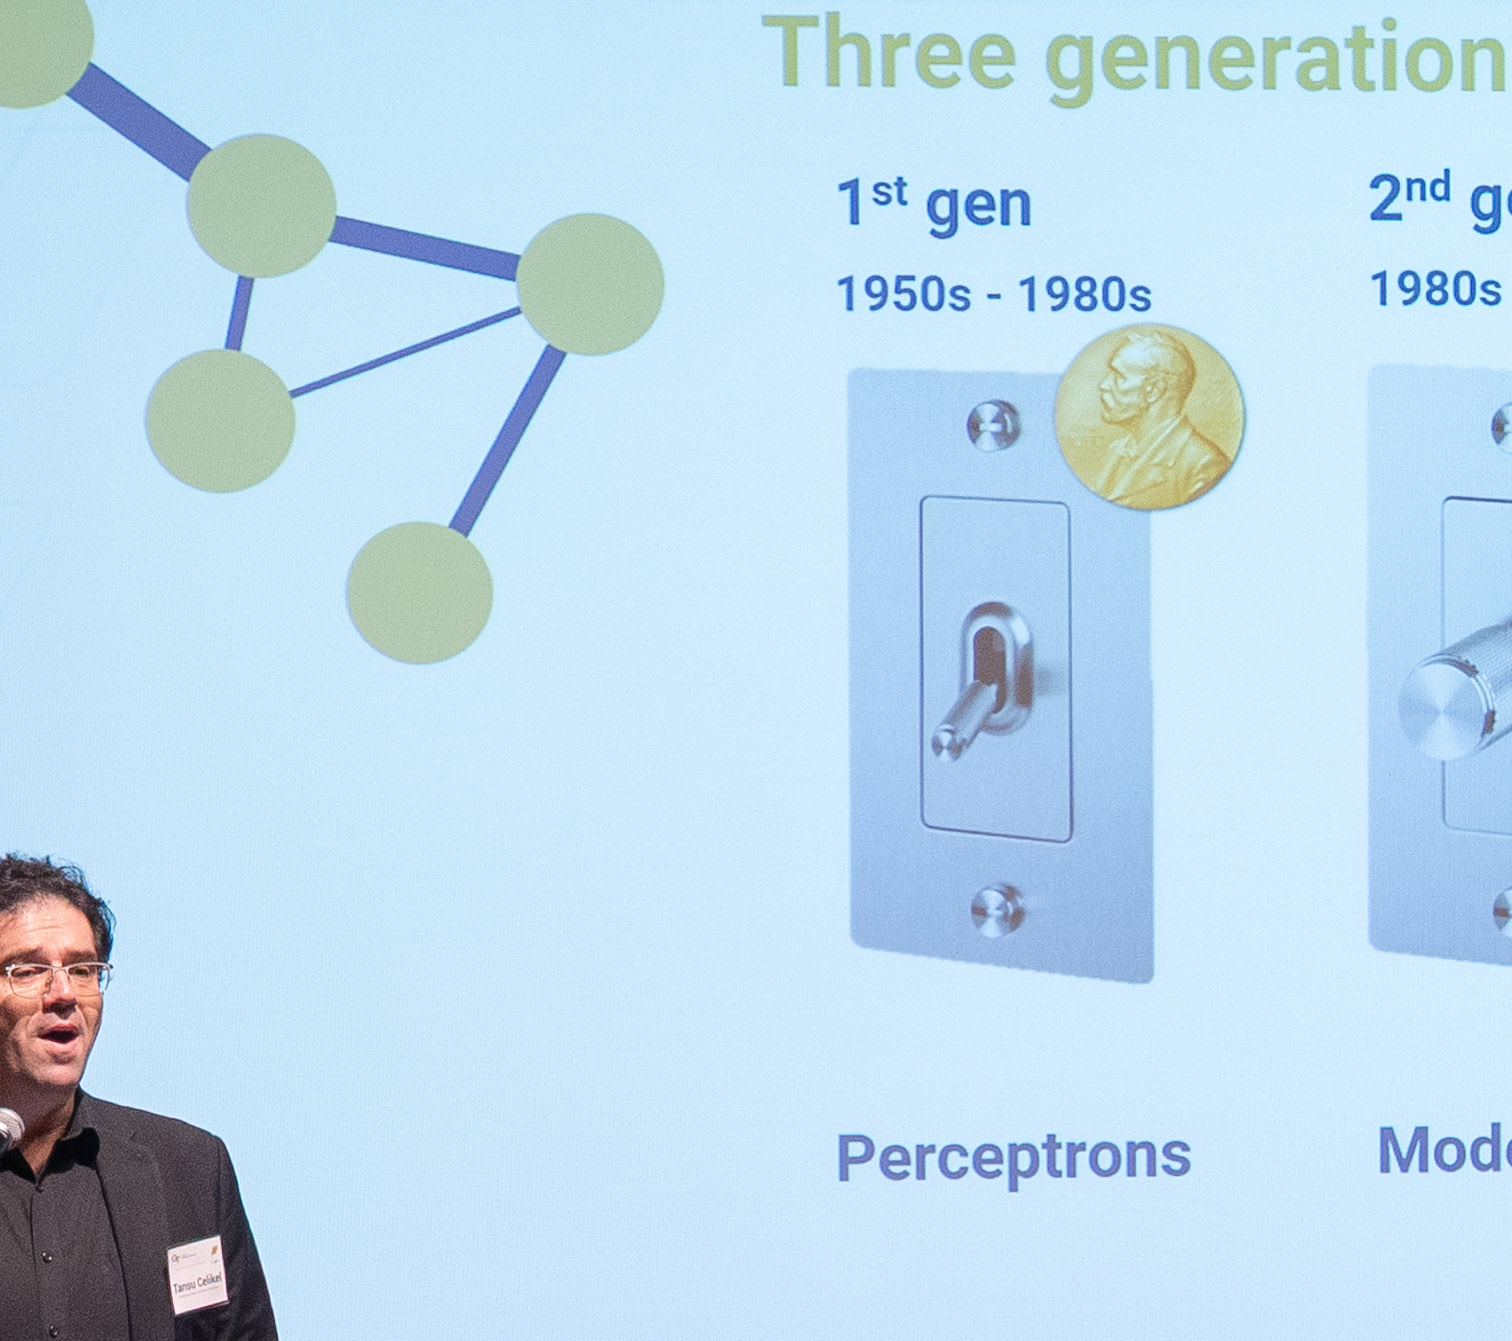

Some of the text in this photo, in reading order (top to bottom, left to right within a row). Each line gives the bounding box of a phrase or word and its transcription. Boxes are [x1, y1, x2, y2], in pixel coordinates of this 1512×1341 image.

[761, 10, 1016, 90] Three
[838, 175, 1031, 240] 1st gen
[1369, 168, 1451, 222] 2nd
[837, 274, 972, 312] 1950s
[1019, 275, 1152, 313] 1980s
[1371, 269, 1502, 307] 1980s
[838, 1133, 1192, 1193] Perceptrons
[173, 1280, 196, 1294] Tansu
